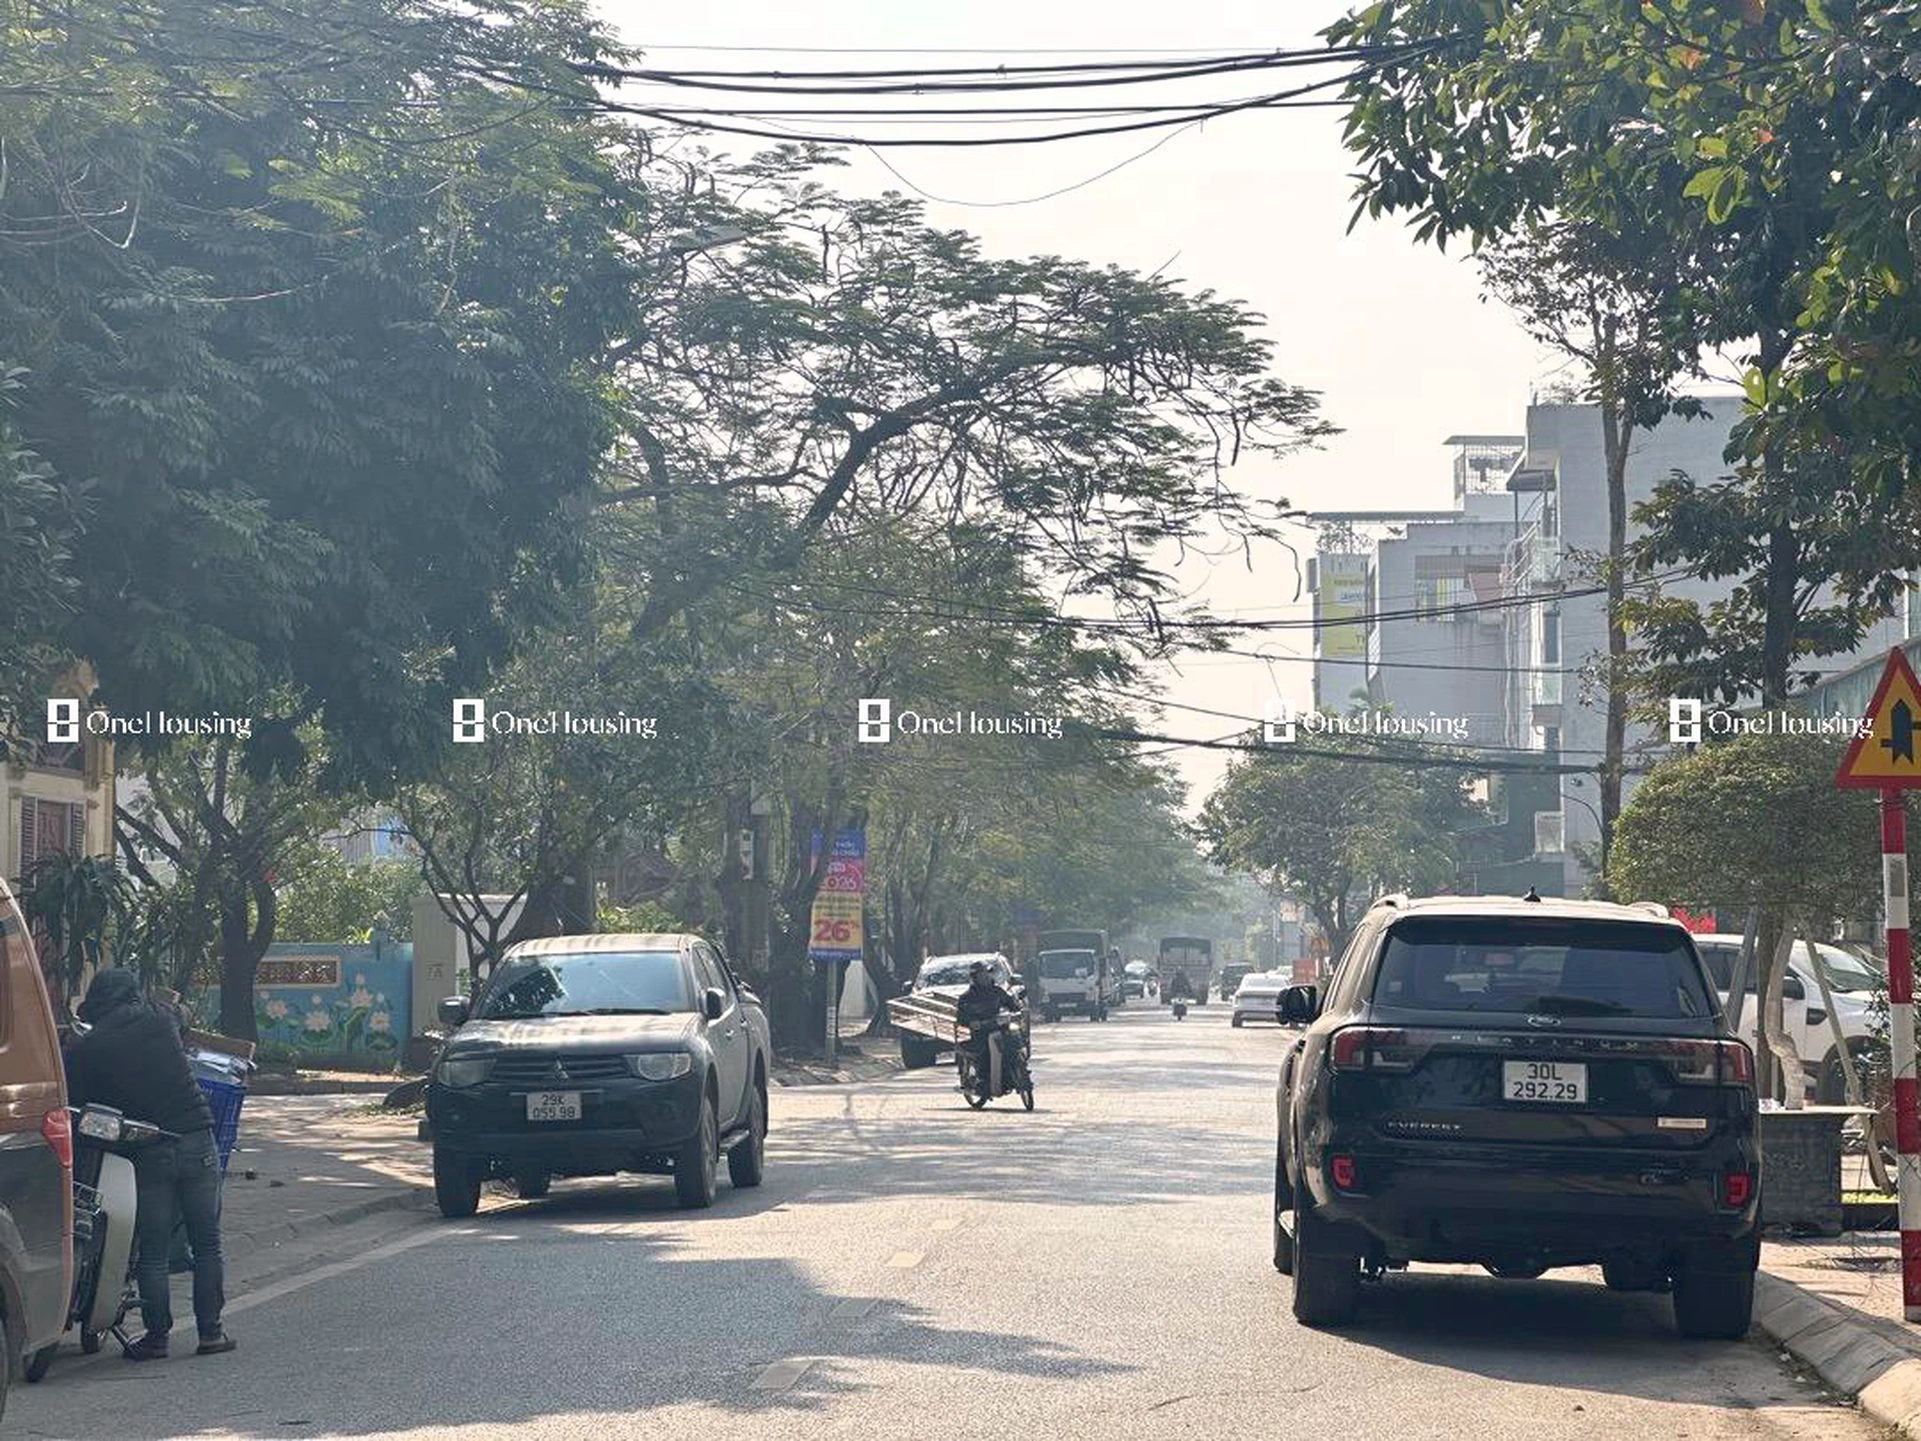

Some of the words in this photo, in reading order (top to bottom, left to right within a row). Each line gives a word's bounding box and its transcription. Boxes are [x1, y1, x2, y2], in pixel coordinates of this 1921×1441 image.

[1527, 1063, 1563, 1080] 30L
[541, 1093, 566, 1105] 29K
[1513, 1081, 1578, 1100] 292.29
